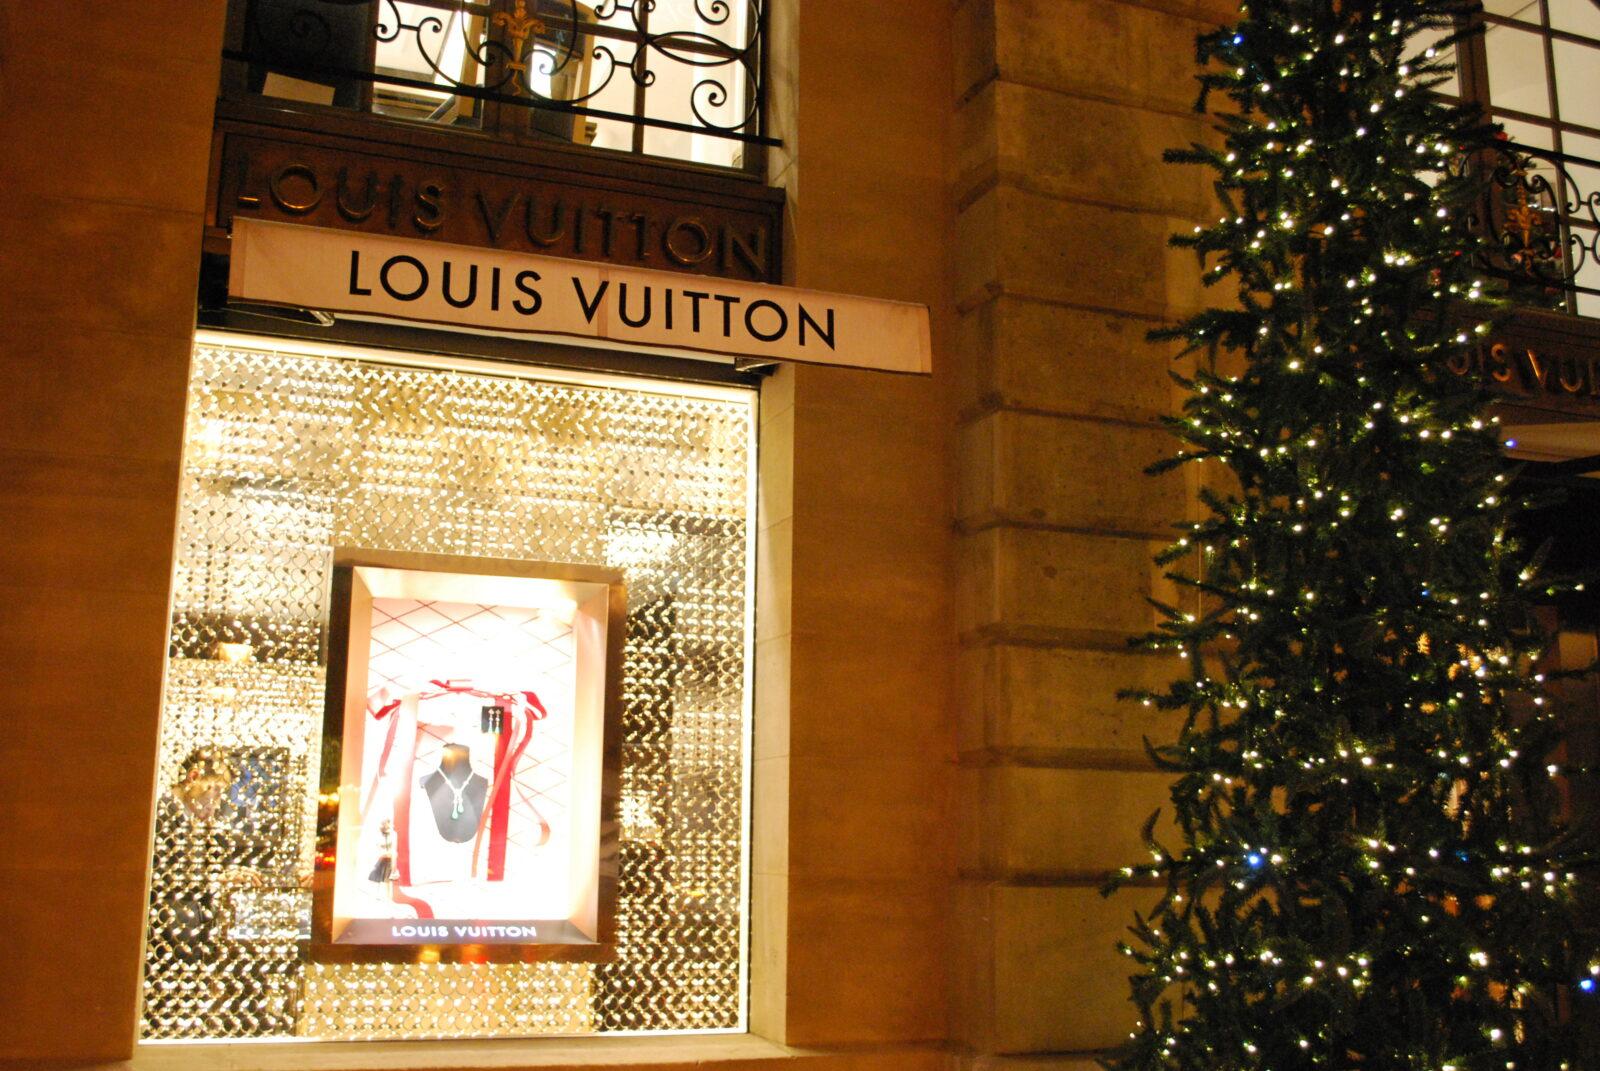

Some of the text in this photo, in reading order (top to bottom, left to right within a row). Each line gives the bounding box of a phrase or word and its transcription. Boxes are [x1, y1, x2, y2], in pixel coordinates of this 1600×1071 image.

[239, 159, 767, 274] LOUIS VUITTON
[349, 250, 836, 352] LOUIS VUITTON
[391, 925, 537, 938] LOUIS VUITTON
